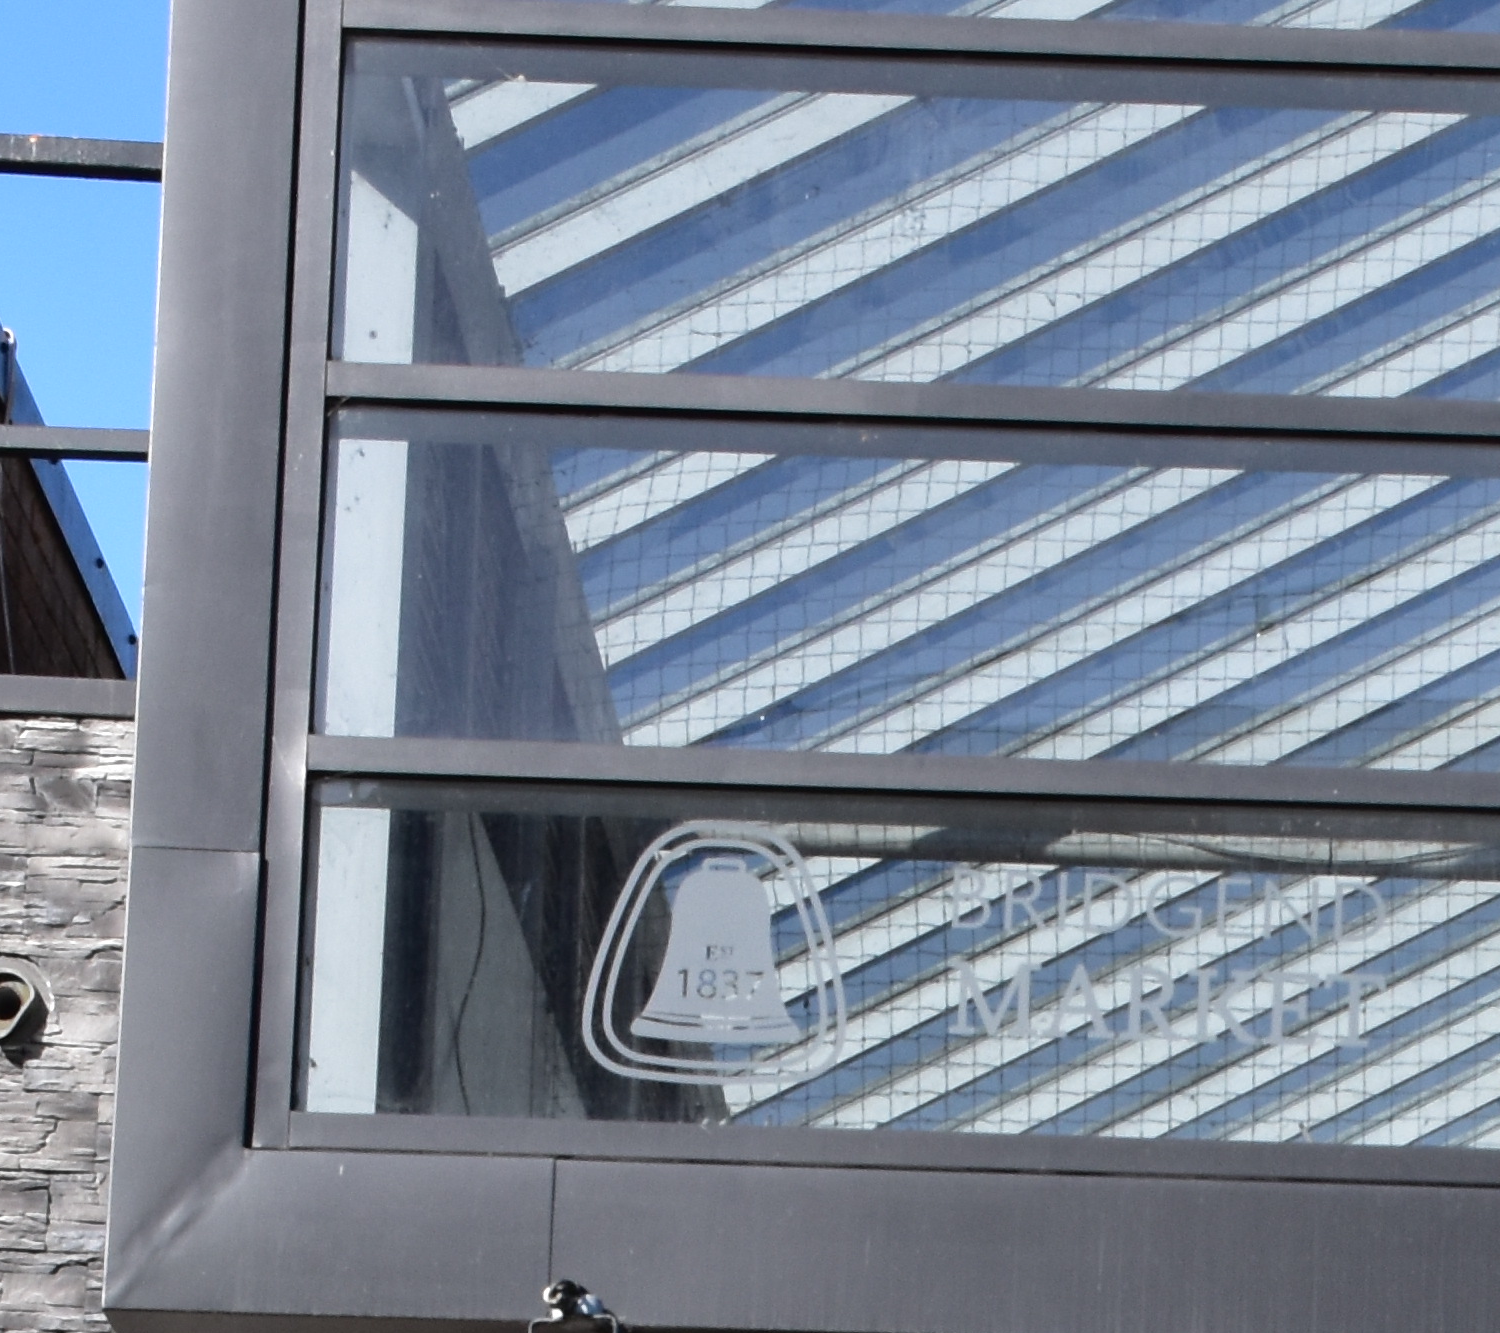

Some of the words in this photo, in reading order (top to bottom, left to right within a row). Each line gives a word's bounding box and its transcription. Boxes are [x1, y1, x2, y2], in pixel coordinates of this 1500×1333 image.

[950, 866, 1388, 943] BRIDGEND
[676, 967, 765, 1001] 1837
[949, 959, 1388, 1048] MARKET
